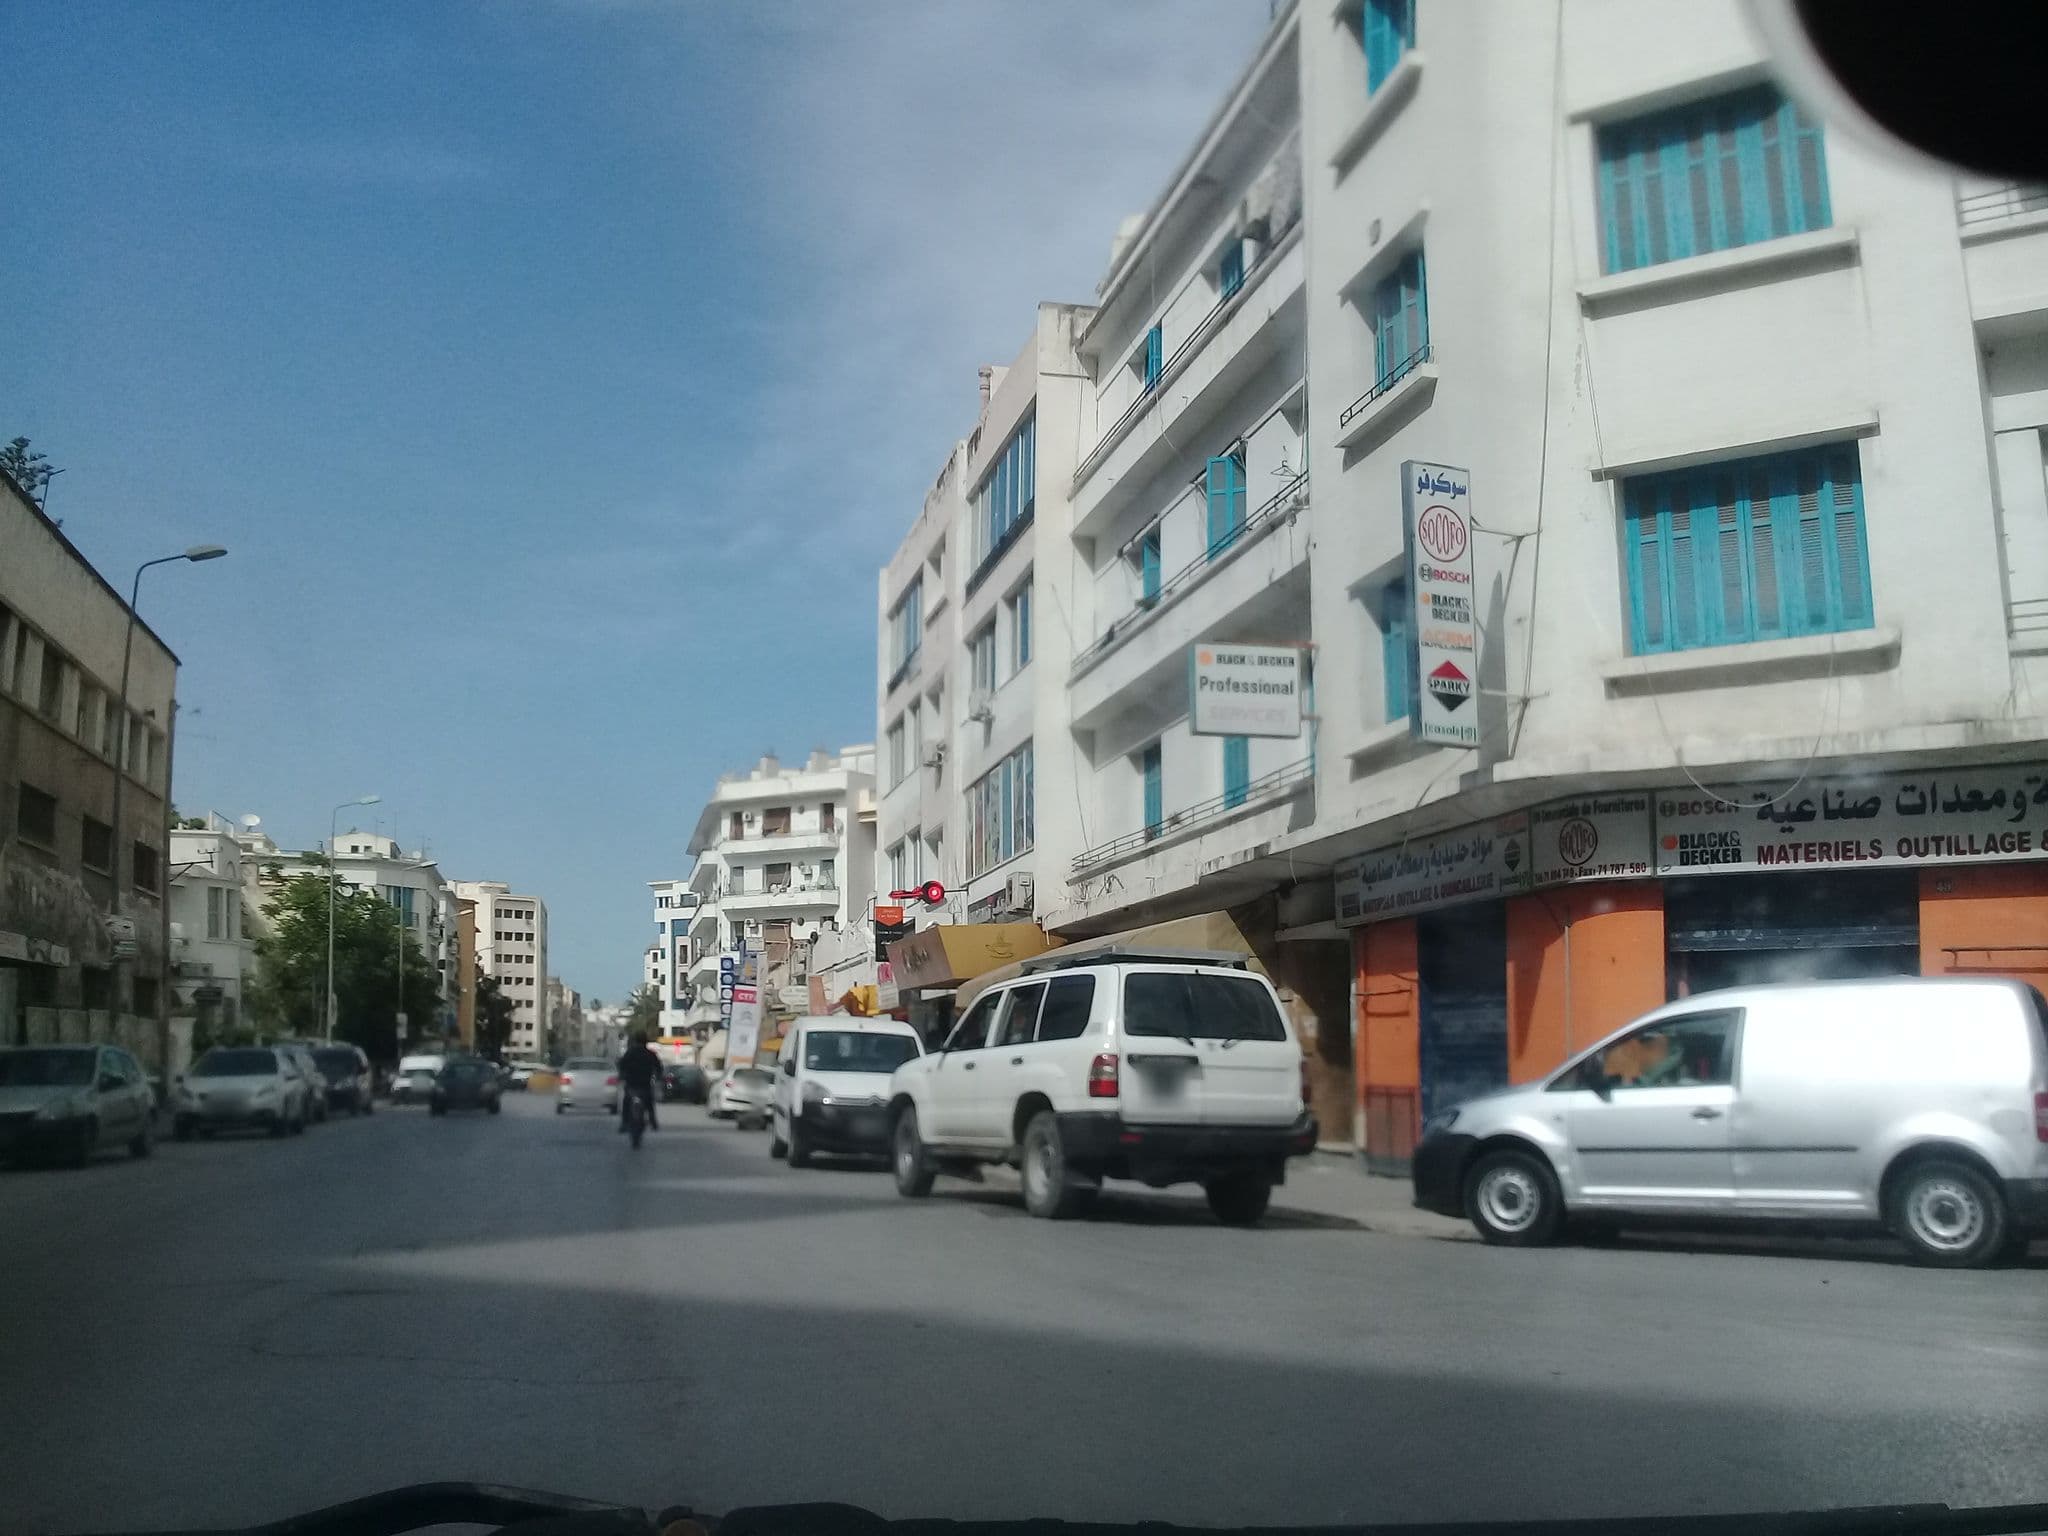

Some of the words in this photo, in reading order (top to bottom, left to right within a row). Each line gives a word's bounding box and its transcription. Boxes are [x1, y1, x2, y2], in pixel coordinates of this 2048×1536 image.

[1416, 468, 1467, 500] سوكوفو
[1422, 512, 1463, 555] SOCOFO
[1432, 569, 1470, 584] BOSCH
[1432, 608, 1470, 623] DECKER
[1216, 654, 1246, 665] BLACK
[1257, 655, 1295, 668] DECKER
[1200, 676, 1294, 695] Professional
[1428, 679, 1470, 695] SPARKY
[1678, 799, 1740, 817] BOSCH
[1753, 788, 1882, 834] صناعية
[1896, 780, 2027, 823] ومعدات
[1680, 847, 1742, 866] DECKER
[1757, 839, 1883, 865] MATERIELS
[1896, 831, 2031, 858] OUTILLAGE
